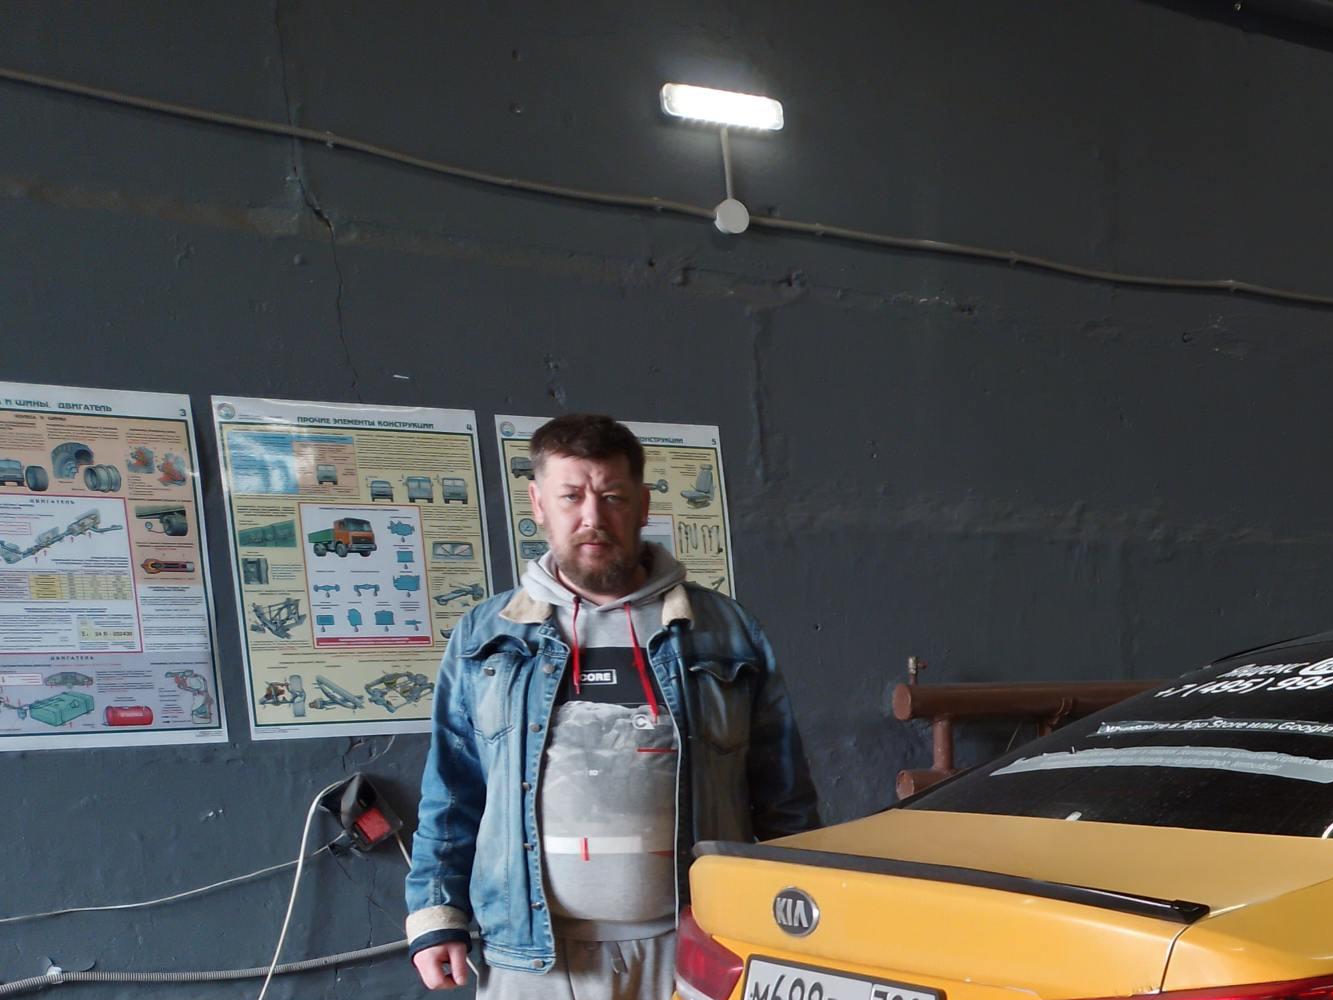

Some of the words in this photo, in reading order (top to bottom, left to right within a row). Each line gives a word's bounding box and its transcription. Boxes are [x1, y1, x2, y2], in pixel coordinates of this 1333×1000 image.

[1180, 677, 1276, 698] (495)
[1208, 719, 1248, 730] Store
[775, 897, 809, 928] KIA
